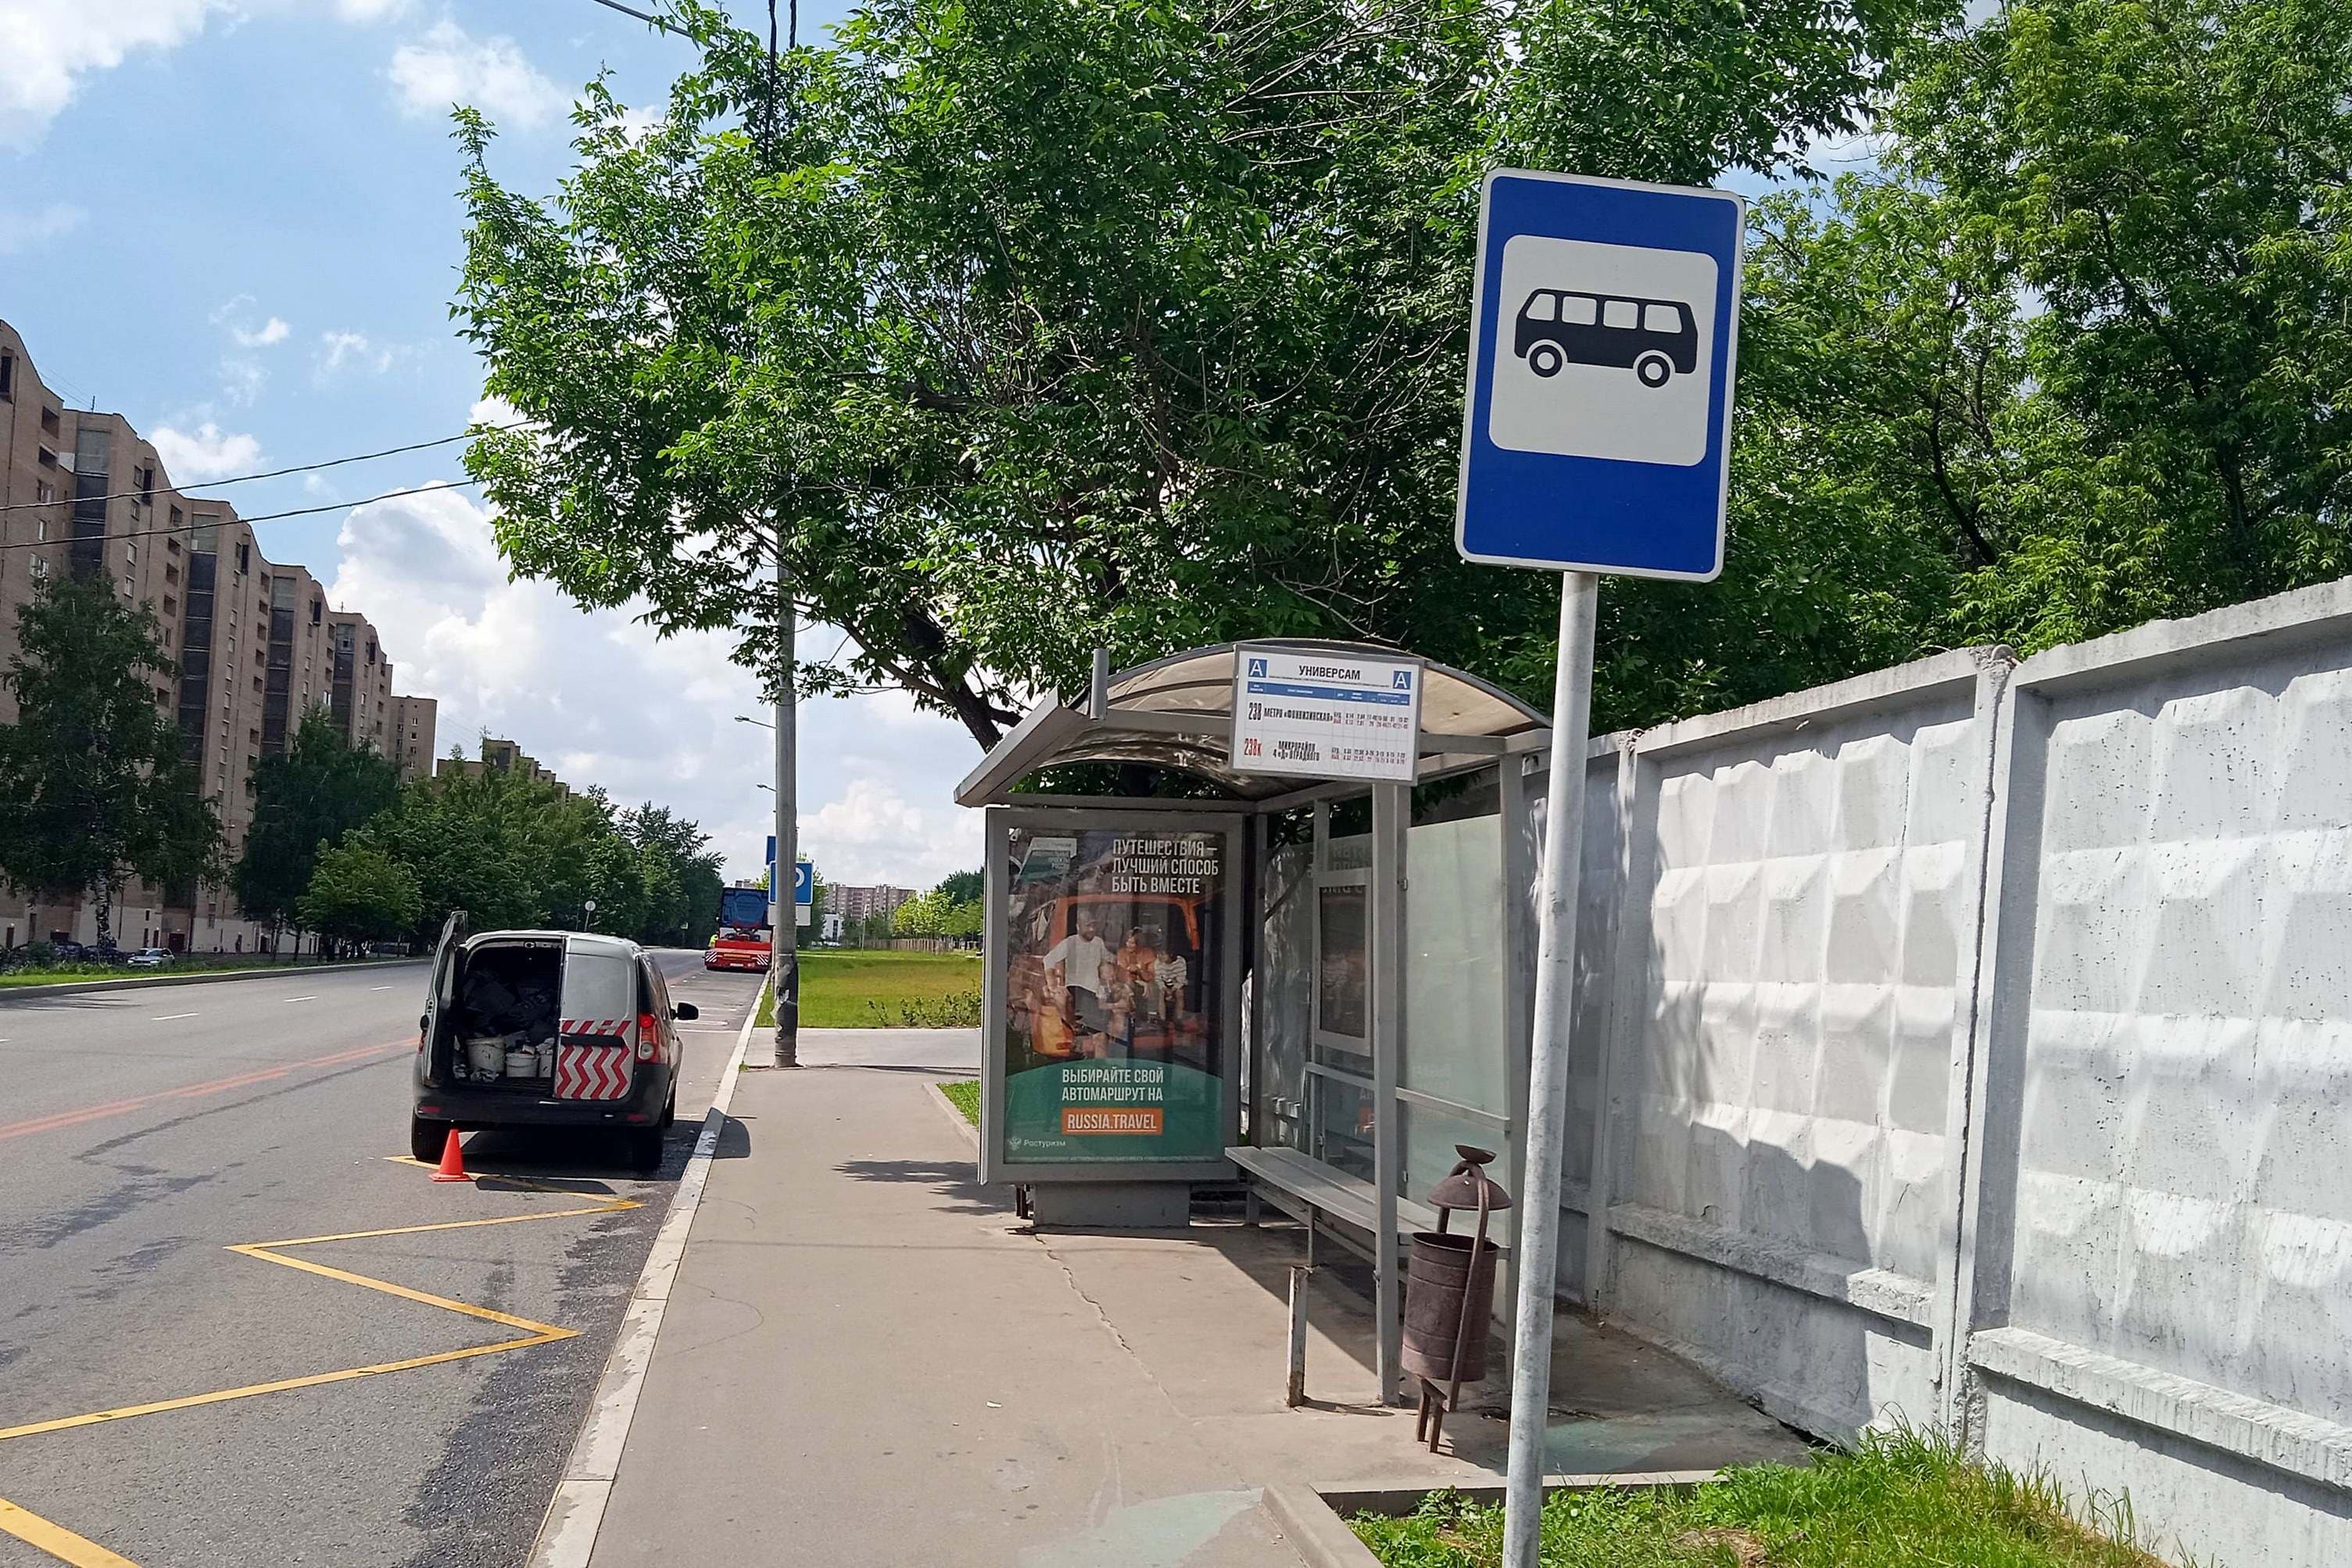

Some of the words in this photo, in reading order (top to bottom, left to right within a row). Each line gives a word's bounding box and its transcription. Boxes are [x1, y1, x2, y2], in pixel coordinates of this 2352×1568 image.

[1298, 664, 1361, 680] УНИВЕРСАМ
[1248, 702, 1262, 721] 238
[1264, 707, 1283, 718] МЕТРО
[1112, 839, 1205, 857] ПУТЕШЕСТВИЯ
[1112, 856, 1168, 875] ЛУЧШИЙ
[1171, 859, 1219, 875] СПОСОБ
[1112, 876, 1147, 893] БЫТЬ
[1151, 877, 1201, 893] ВМЕСТЕ
[1062, 1066, 1132, 1083] ВЫБИРАЙТЕ
[1134, 1067, 1164, 1083] СВОЙ
[1061, 1087, 1146, 1101] АВТОМАРШРУТ
[1147, 1087, 1163, 1101] НА
[1067, 1113, 1158, 1129] RUSSIA.TRAVEL
[1023, 1139, 1066, 1148] Ростуризм
